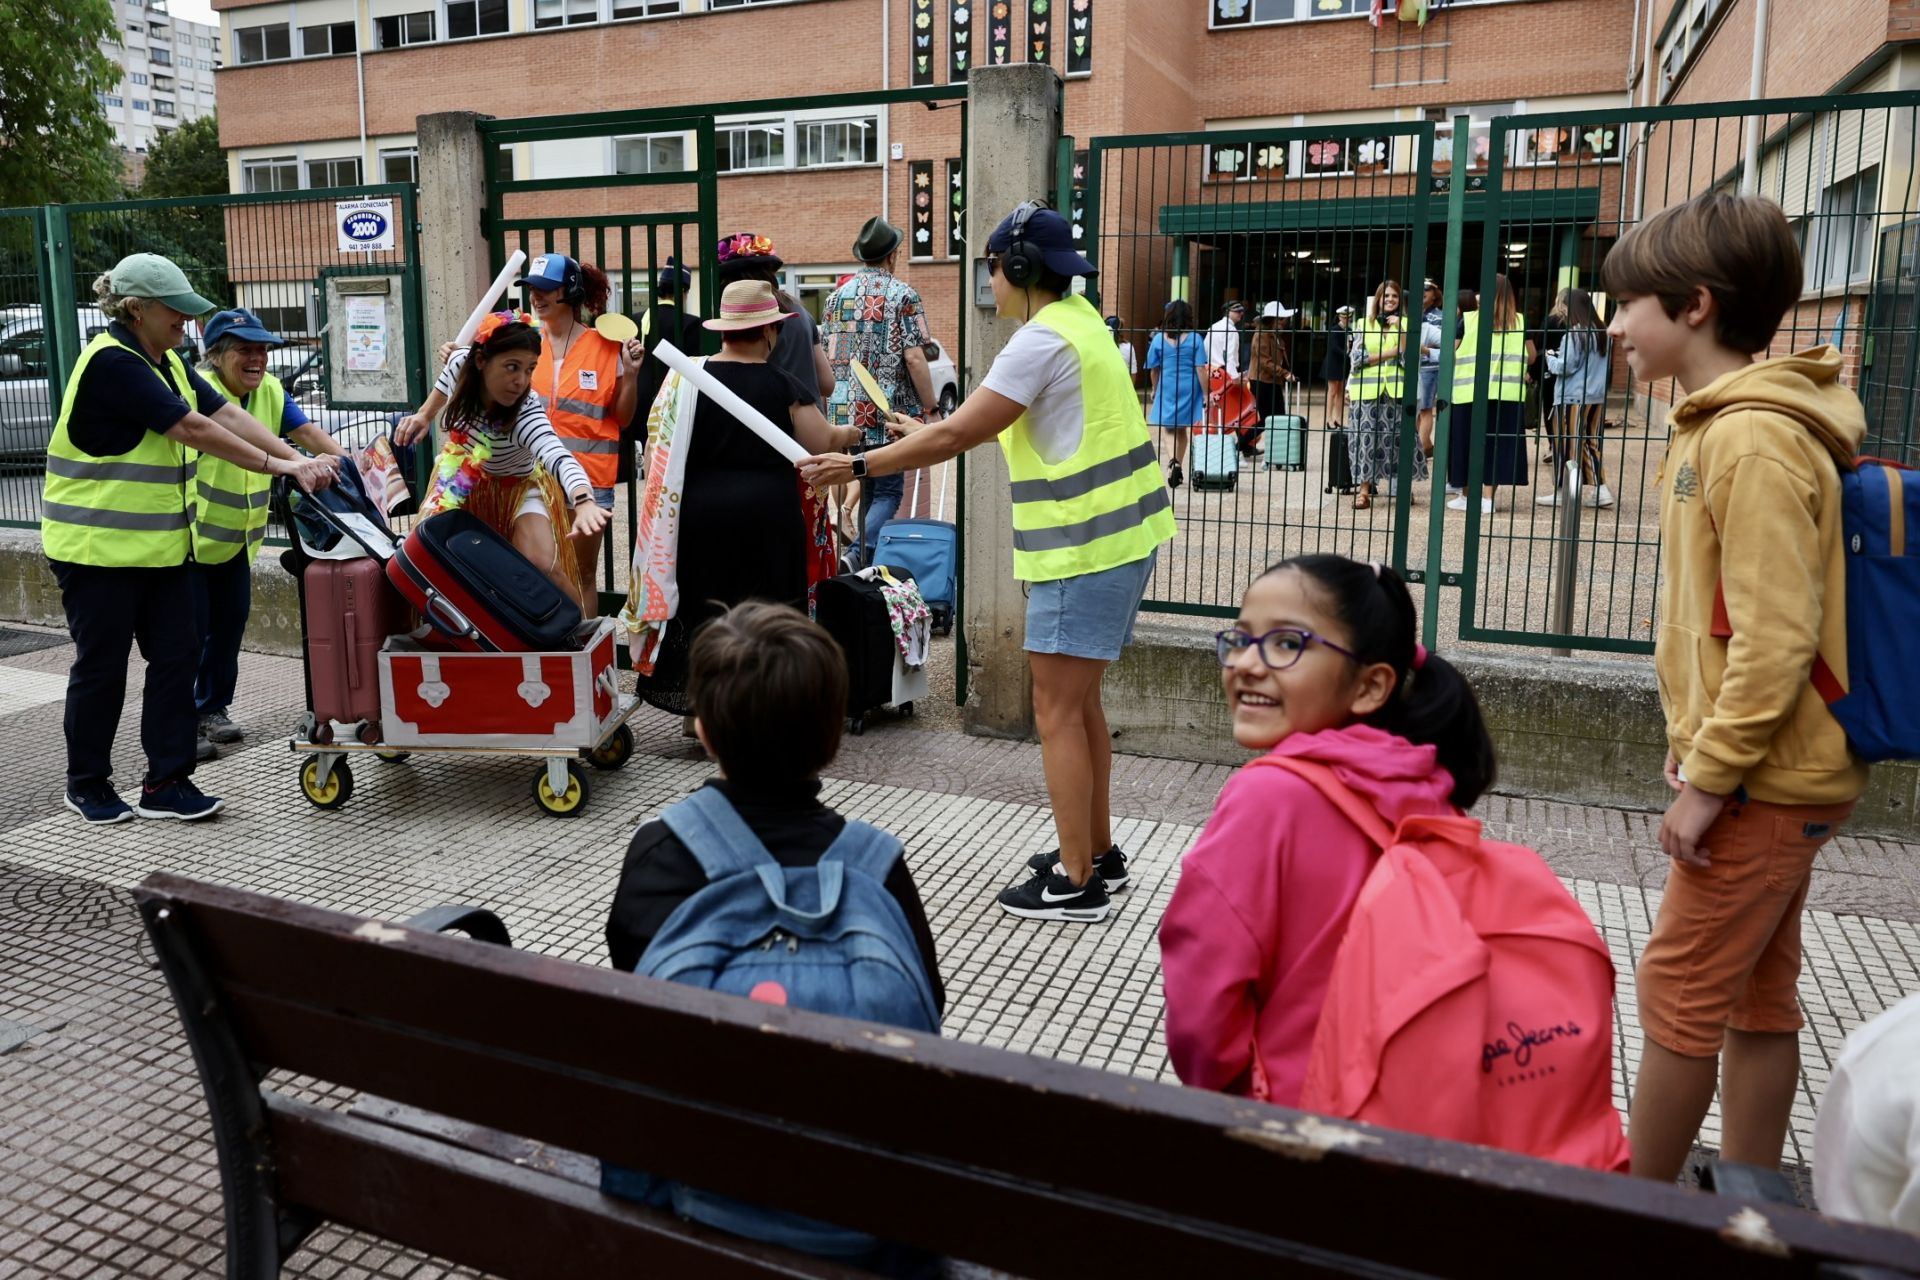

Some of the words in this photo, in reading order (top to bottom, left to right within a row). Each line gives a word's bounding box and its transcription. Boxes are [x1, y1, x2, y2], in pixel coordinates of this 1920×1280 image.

[347, 213, 381, 224] SEGURIDAD
[352, 221, 377, 236] 2000
[1507, 1021, 1580, 1067] Jeans
